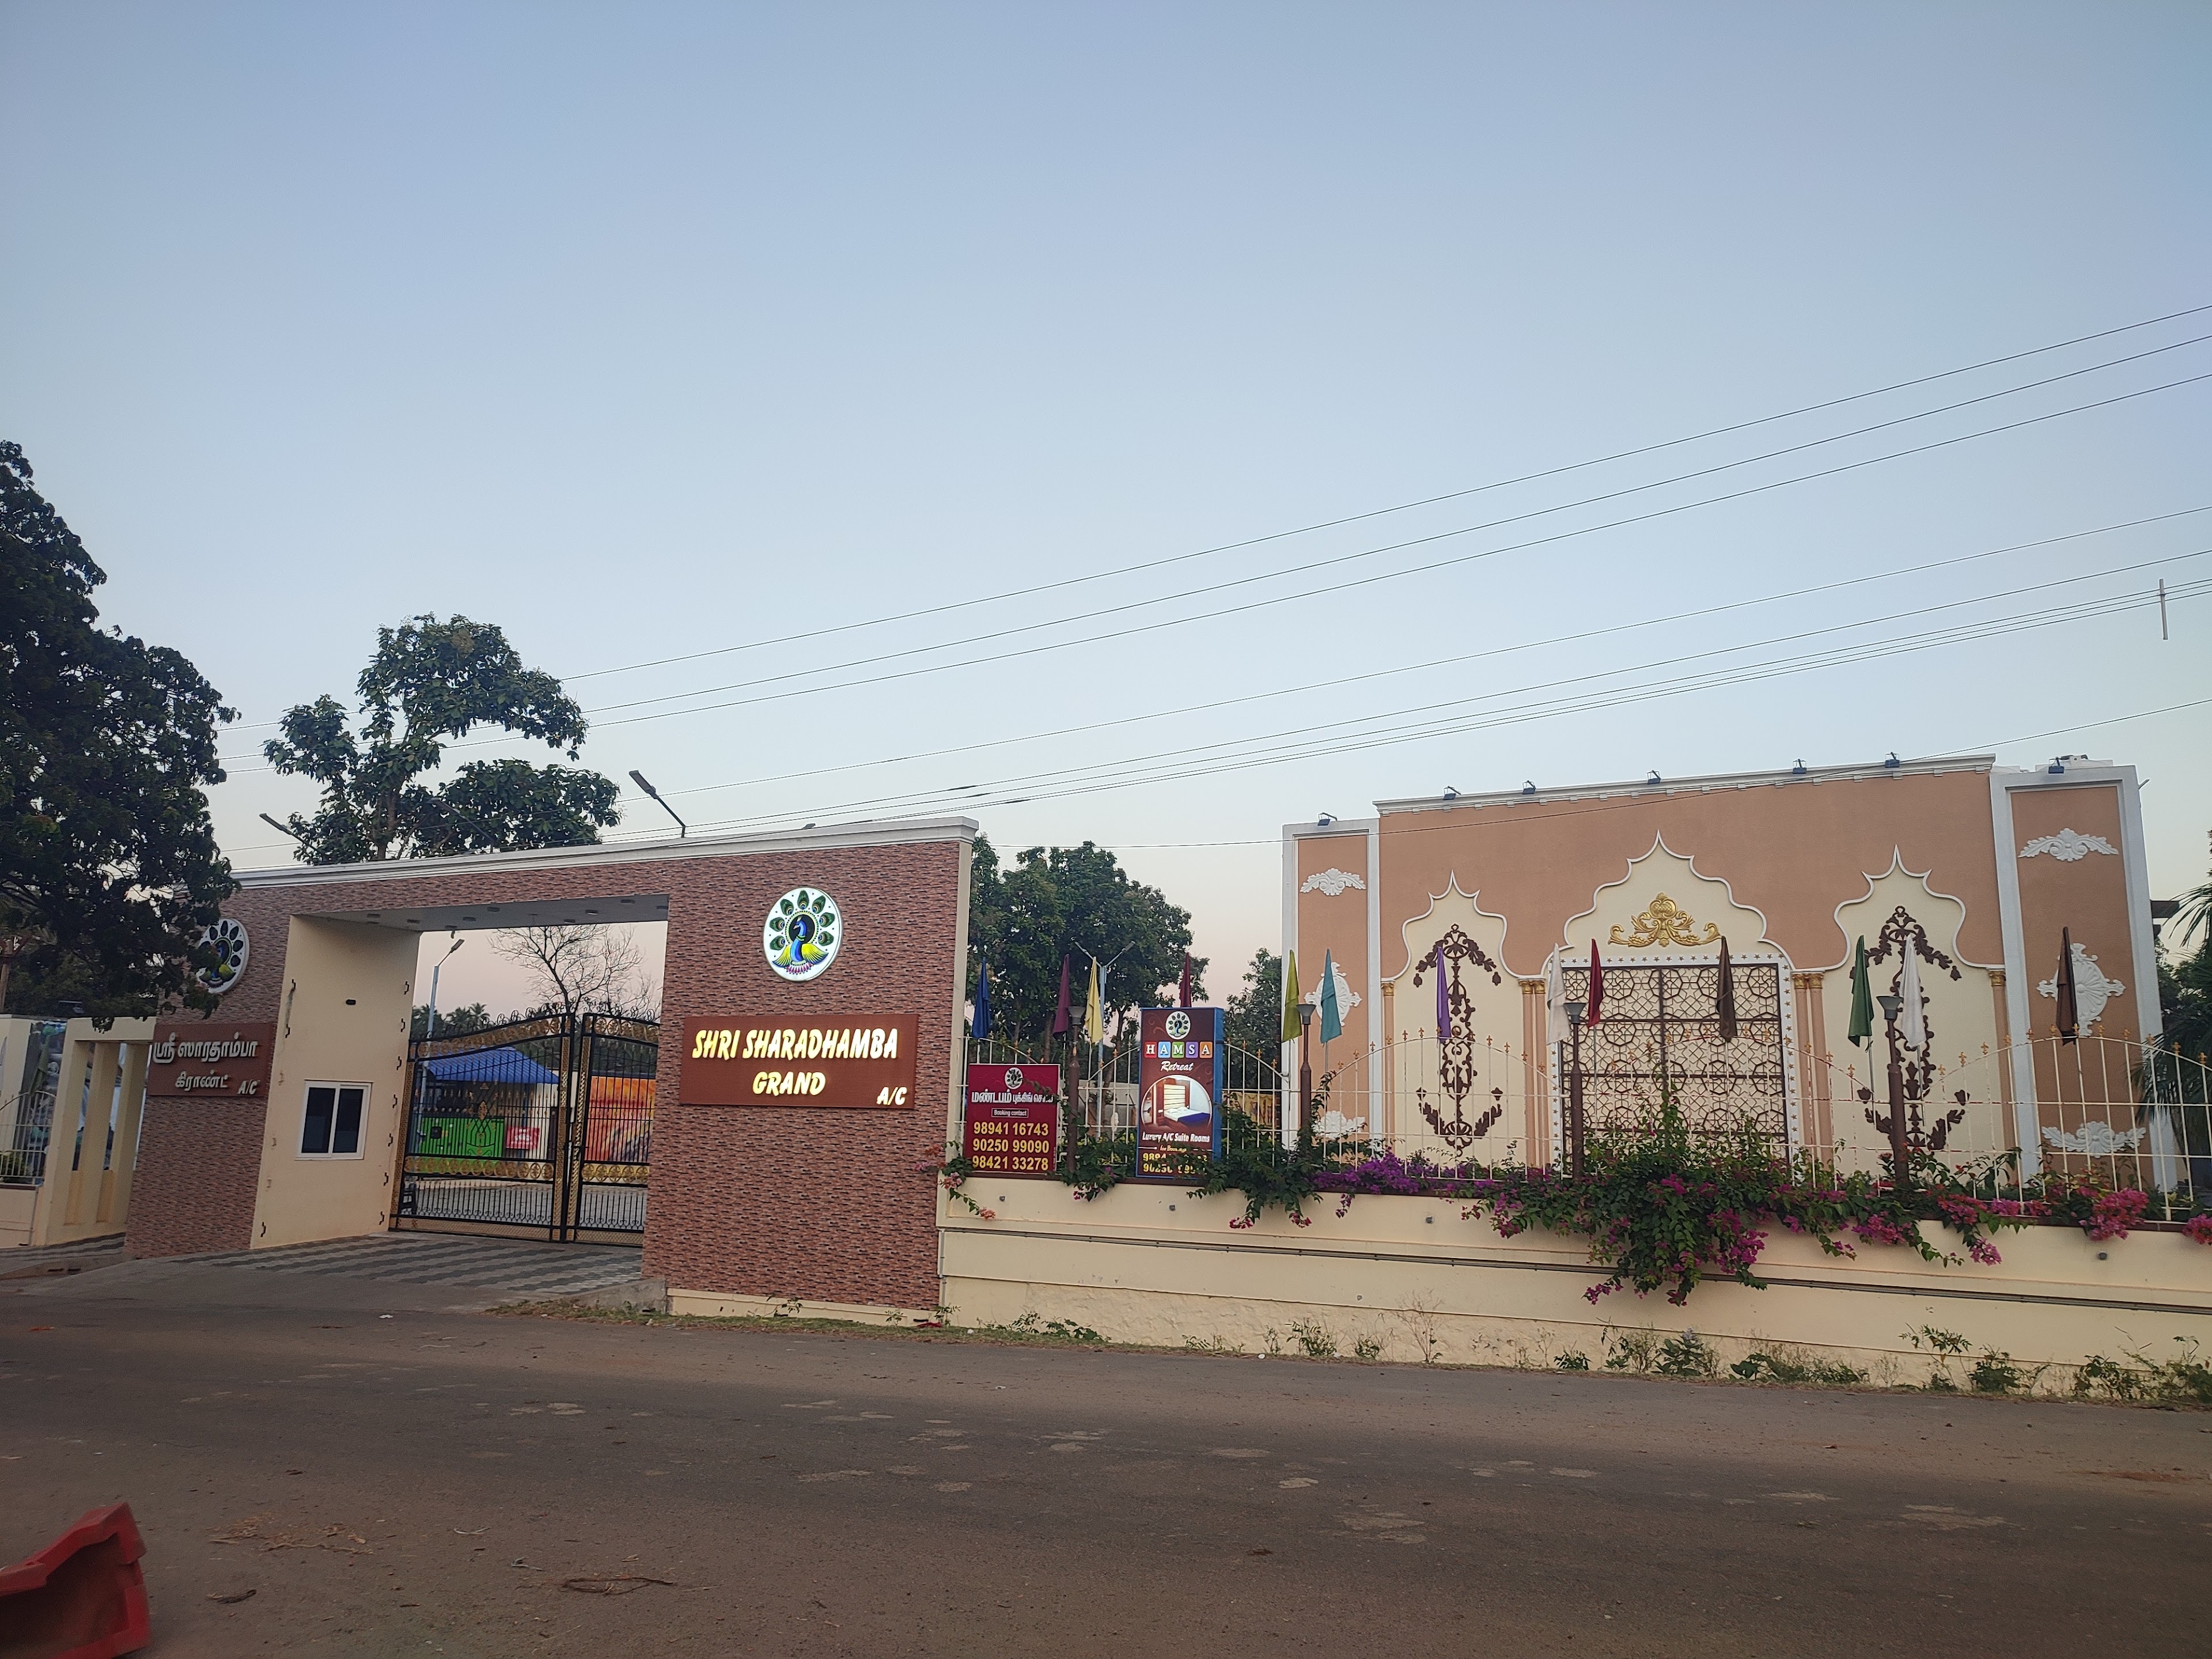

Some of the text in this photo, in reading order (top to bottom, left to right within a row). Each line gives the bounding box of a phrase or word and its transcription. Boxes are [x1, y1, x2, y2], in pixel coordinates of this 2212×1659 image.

[692, 1028, 898, 1060] SHRI SHARADHAMBA
[1145, 1043, 1210, 1056] HAMSA
[1160, 1060, 1194, 1071] Retreat
[237, 1080, 259, 1094] A/C
[752, 1071, 825, 1096] GRAND
[876, 1087, 907, 1105] A/C
[971, 1089, 1012, 1103] மண்டபம்
[974, 1122, 1048, 1136] 98941 16743
[1162, 1132, 1174, 1142] A/C
[1175, 1133, 1189, 1142] Suite
[1190, 1134, 1210, 1142] Rooms
[972, 1138, 1050, 1153] 90250 99090
[972, 1155, 1008, 1169] 98421
[1012, 1157, 1048, 1171] 33278
